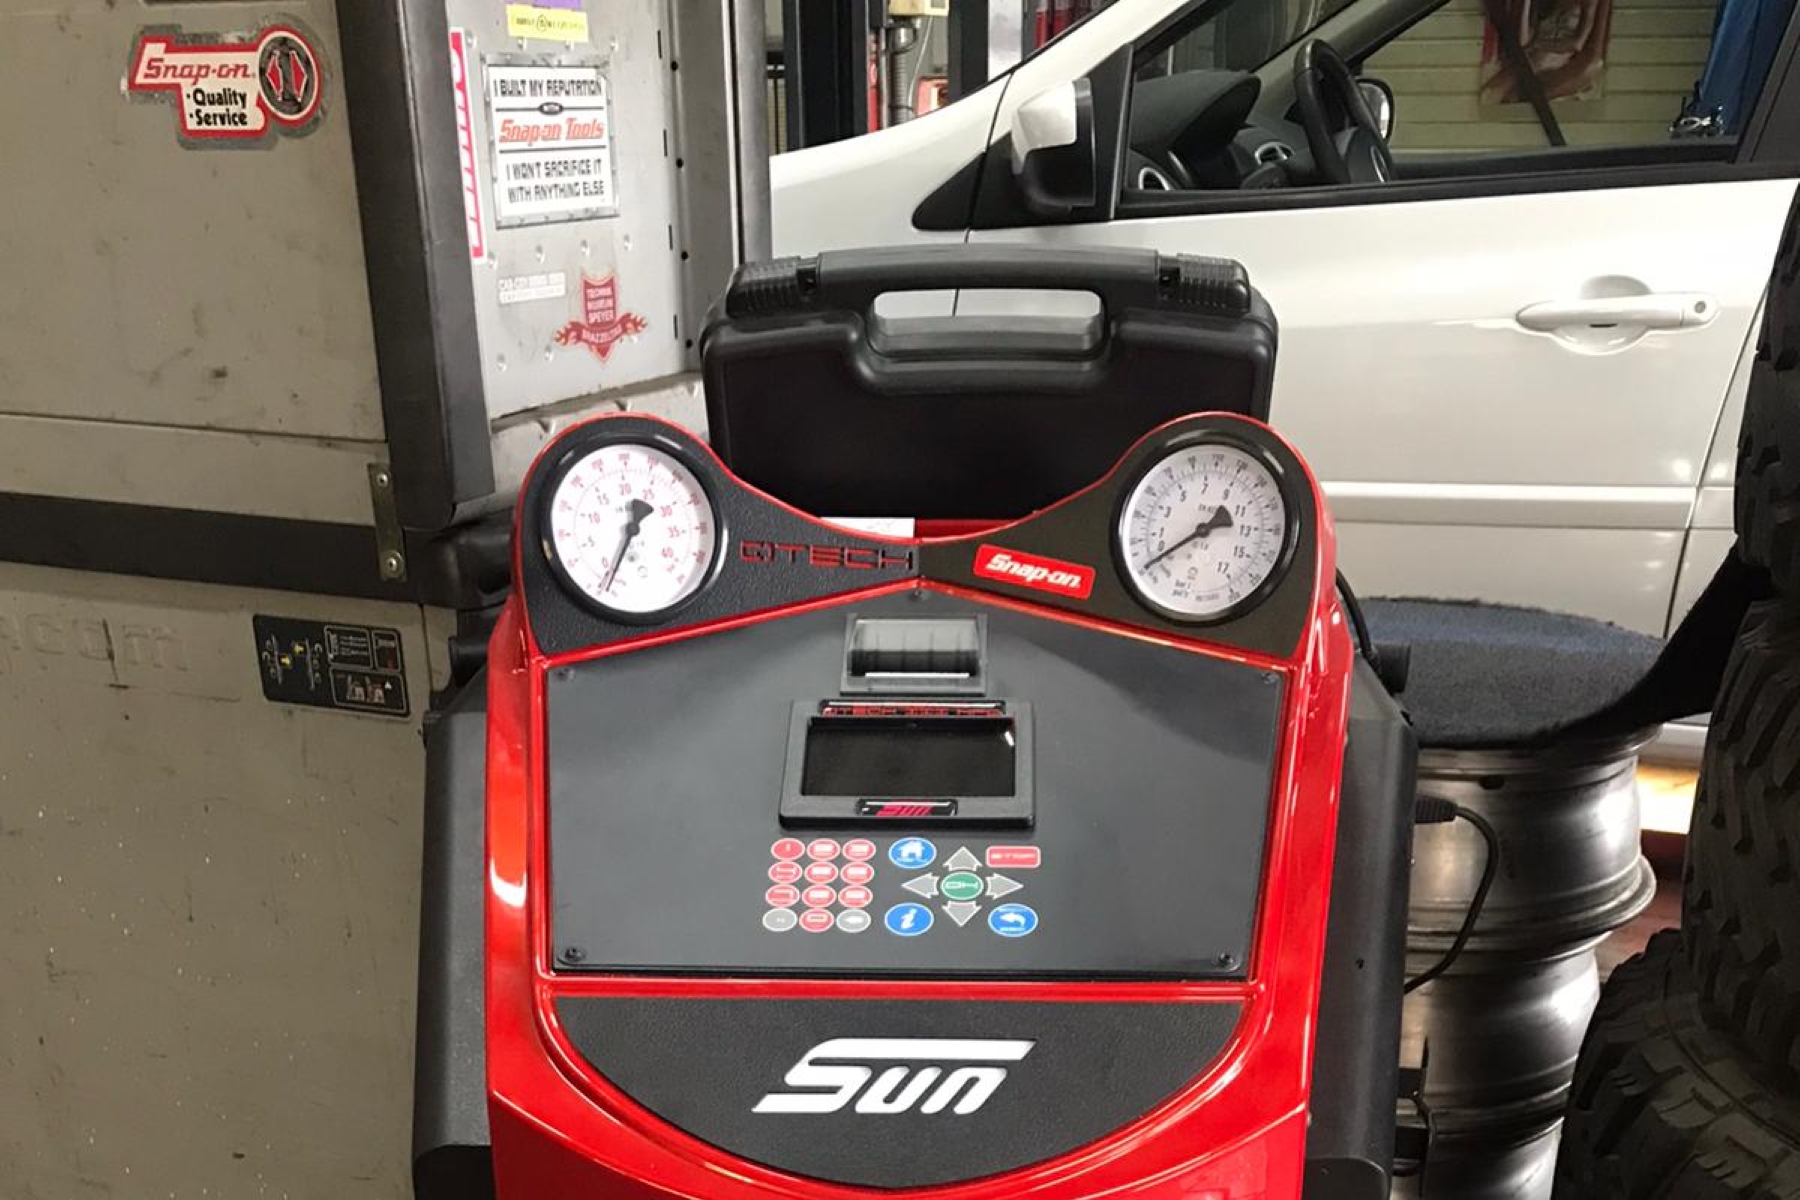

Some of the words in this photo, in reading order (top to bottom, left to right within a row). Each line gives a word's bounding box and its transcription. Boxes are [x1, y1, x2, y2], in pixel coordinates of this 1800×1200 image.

[143, 57, 252, 85] Snap-on
[500, 79, 526, 97] BUILT
[529, 79, 545, 97] MY
[546, 79, 603, 97] REPUTATION
[192, 89, 248, 109] Quality
[195, 109, 248, 127] Service
[499, 119, 561, 146] Snap-on
[565, 117, 605, 140] Tools
[544, 159, 592, 179] SACRIFICE
[594, 158, 602, 176] IT
[508, 185, 532, 203] WITH
[533, 182, 581, 202] ANYTHING
[582, 180, 605, 197] ELSE
[619, 483, 631, 496] 20
[1201, 483, 1209, 494] 7
[1180, 490, 1186, 502] 5
[660, 505, 673, 517] 30
[1164, 506, 1171, 518] 3
[1234, 505, 1245, 517] 11
[588, 512, 600, 524] 10
[1240, 525, 1251, 537] 13
[1234, 546, 1245, 559] 15
[985, 553, 1081, 589] Snap-on
[1217, 561, 1230, 574] 17
